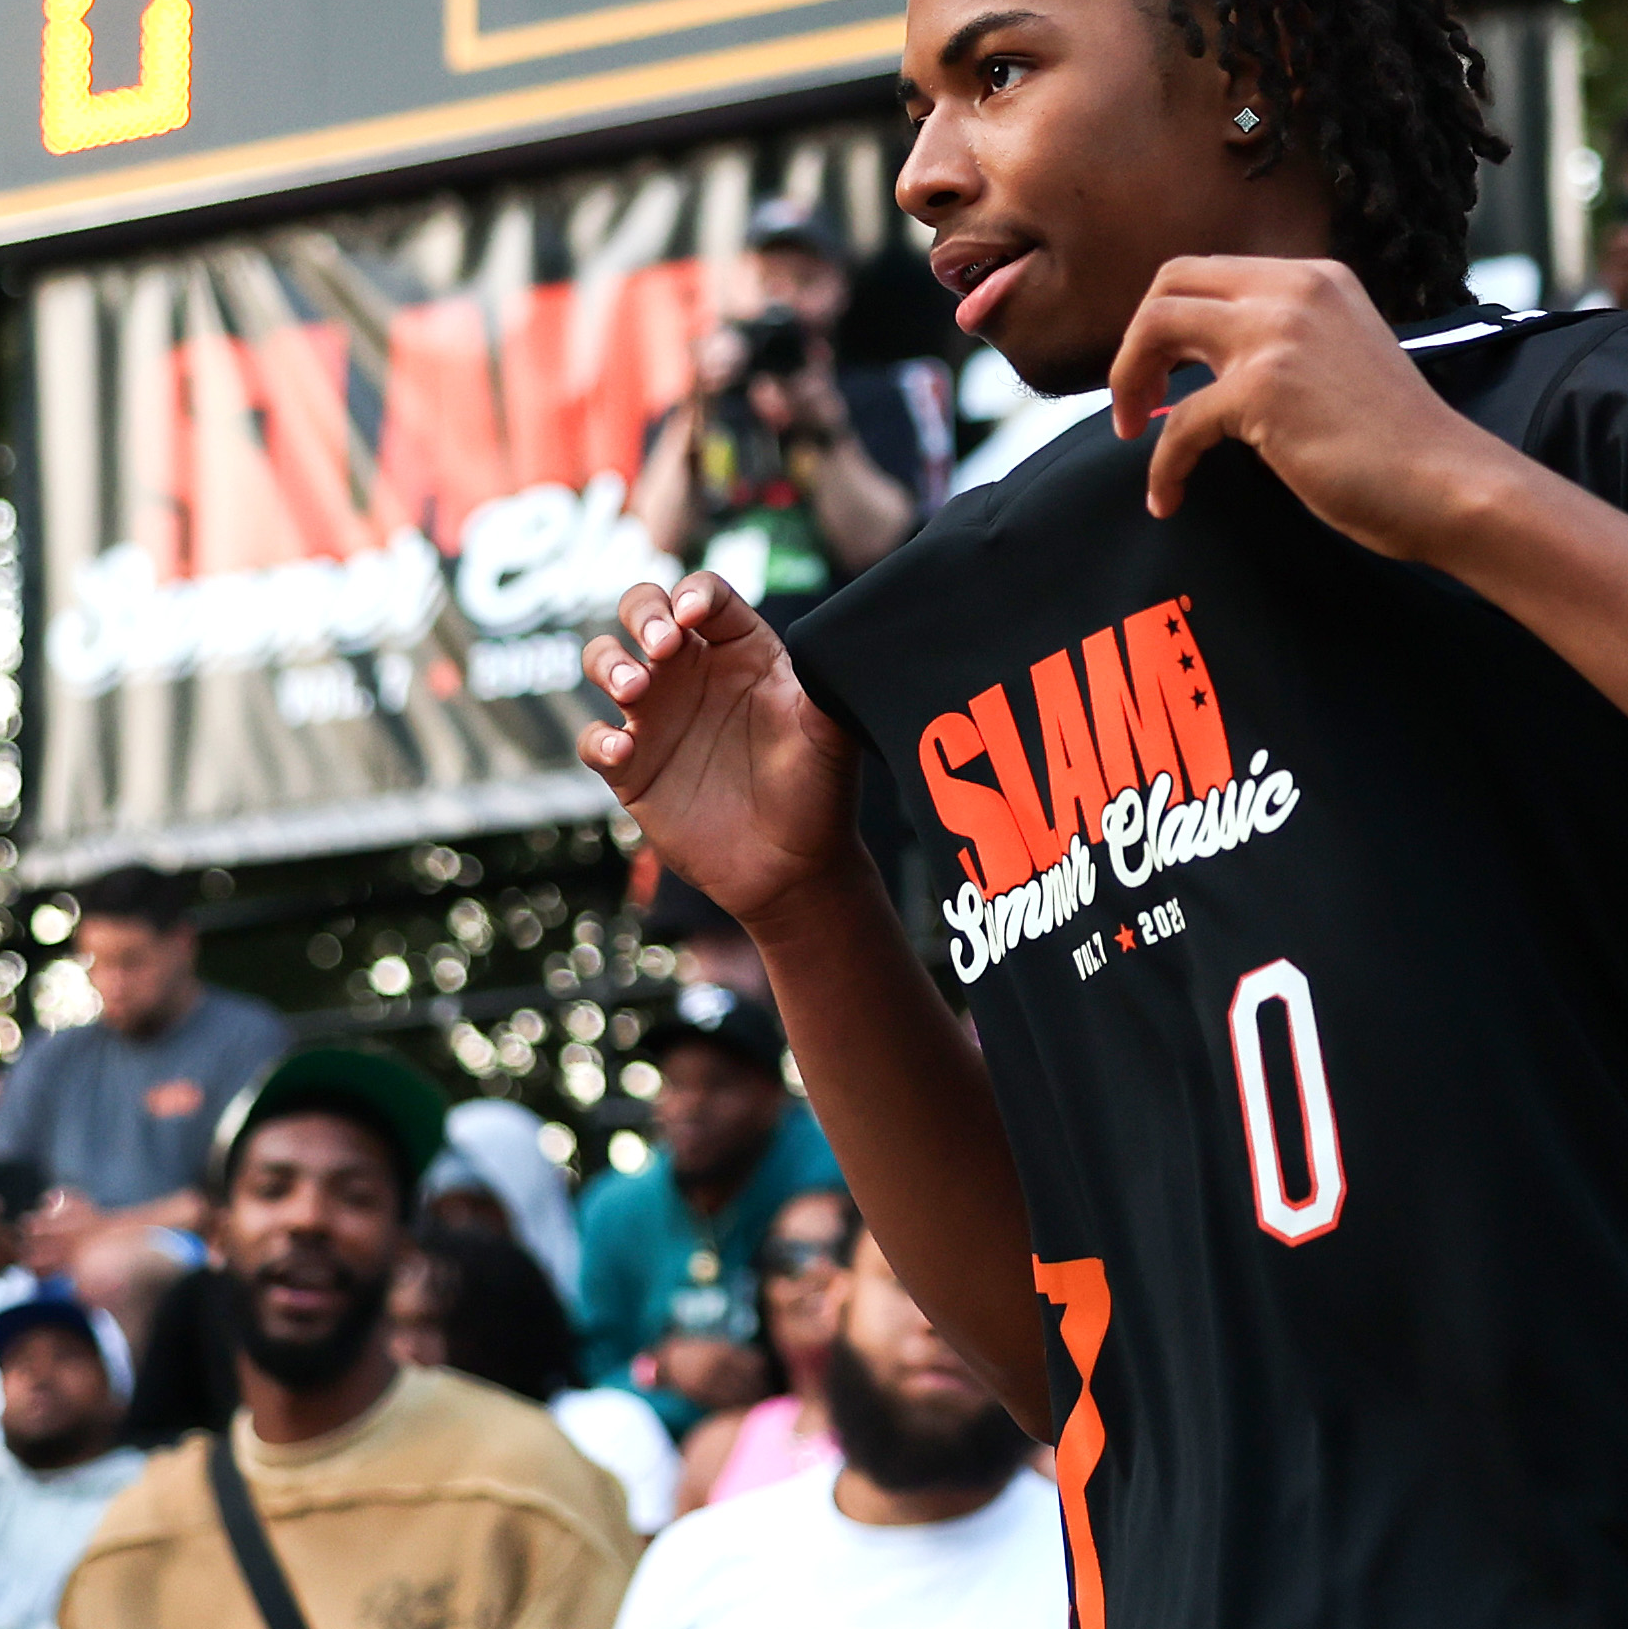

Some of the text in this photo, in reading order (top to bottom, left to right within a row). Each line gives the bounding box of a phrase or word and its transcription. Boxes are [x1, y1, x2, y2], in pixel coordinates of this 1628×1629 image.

[918, 598, 1233, 901] SLAM
[942, 749, 1301, 984] Summr Classic
[1227, 957, 1348, 1248] 0
